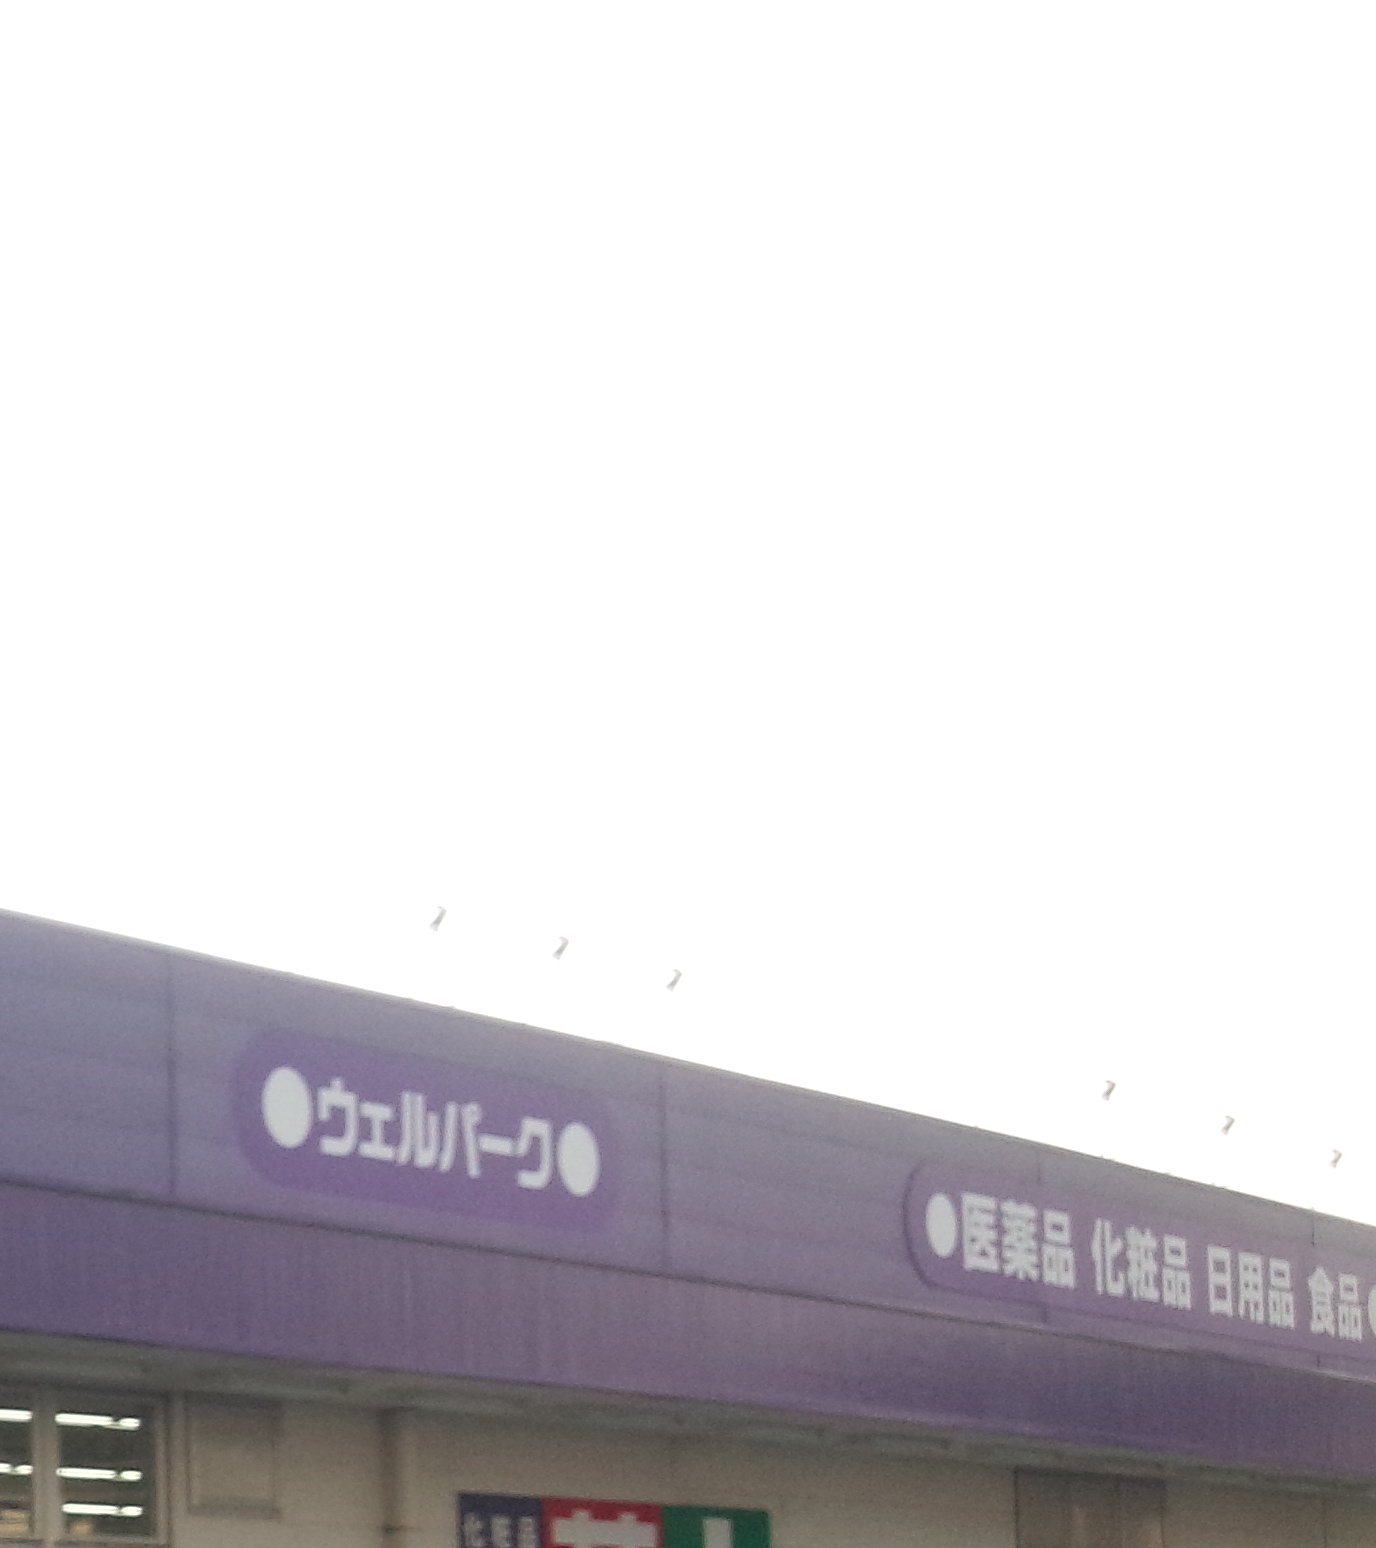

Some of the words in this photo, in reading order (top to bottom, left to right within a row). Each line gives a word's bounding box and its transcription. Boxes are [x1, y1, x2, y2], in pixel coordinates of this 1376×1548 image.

[316, 1077, 553, 1190] ウェルパーク
[960, 1191, 1076, 1290] 医薬品
[1091, 1217, 1192, 1311] 化粧品
[1207, 1244, 1295, 1331] 日用品
[1308, 1266, 1363, 1343] 食品
